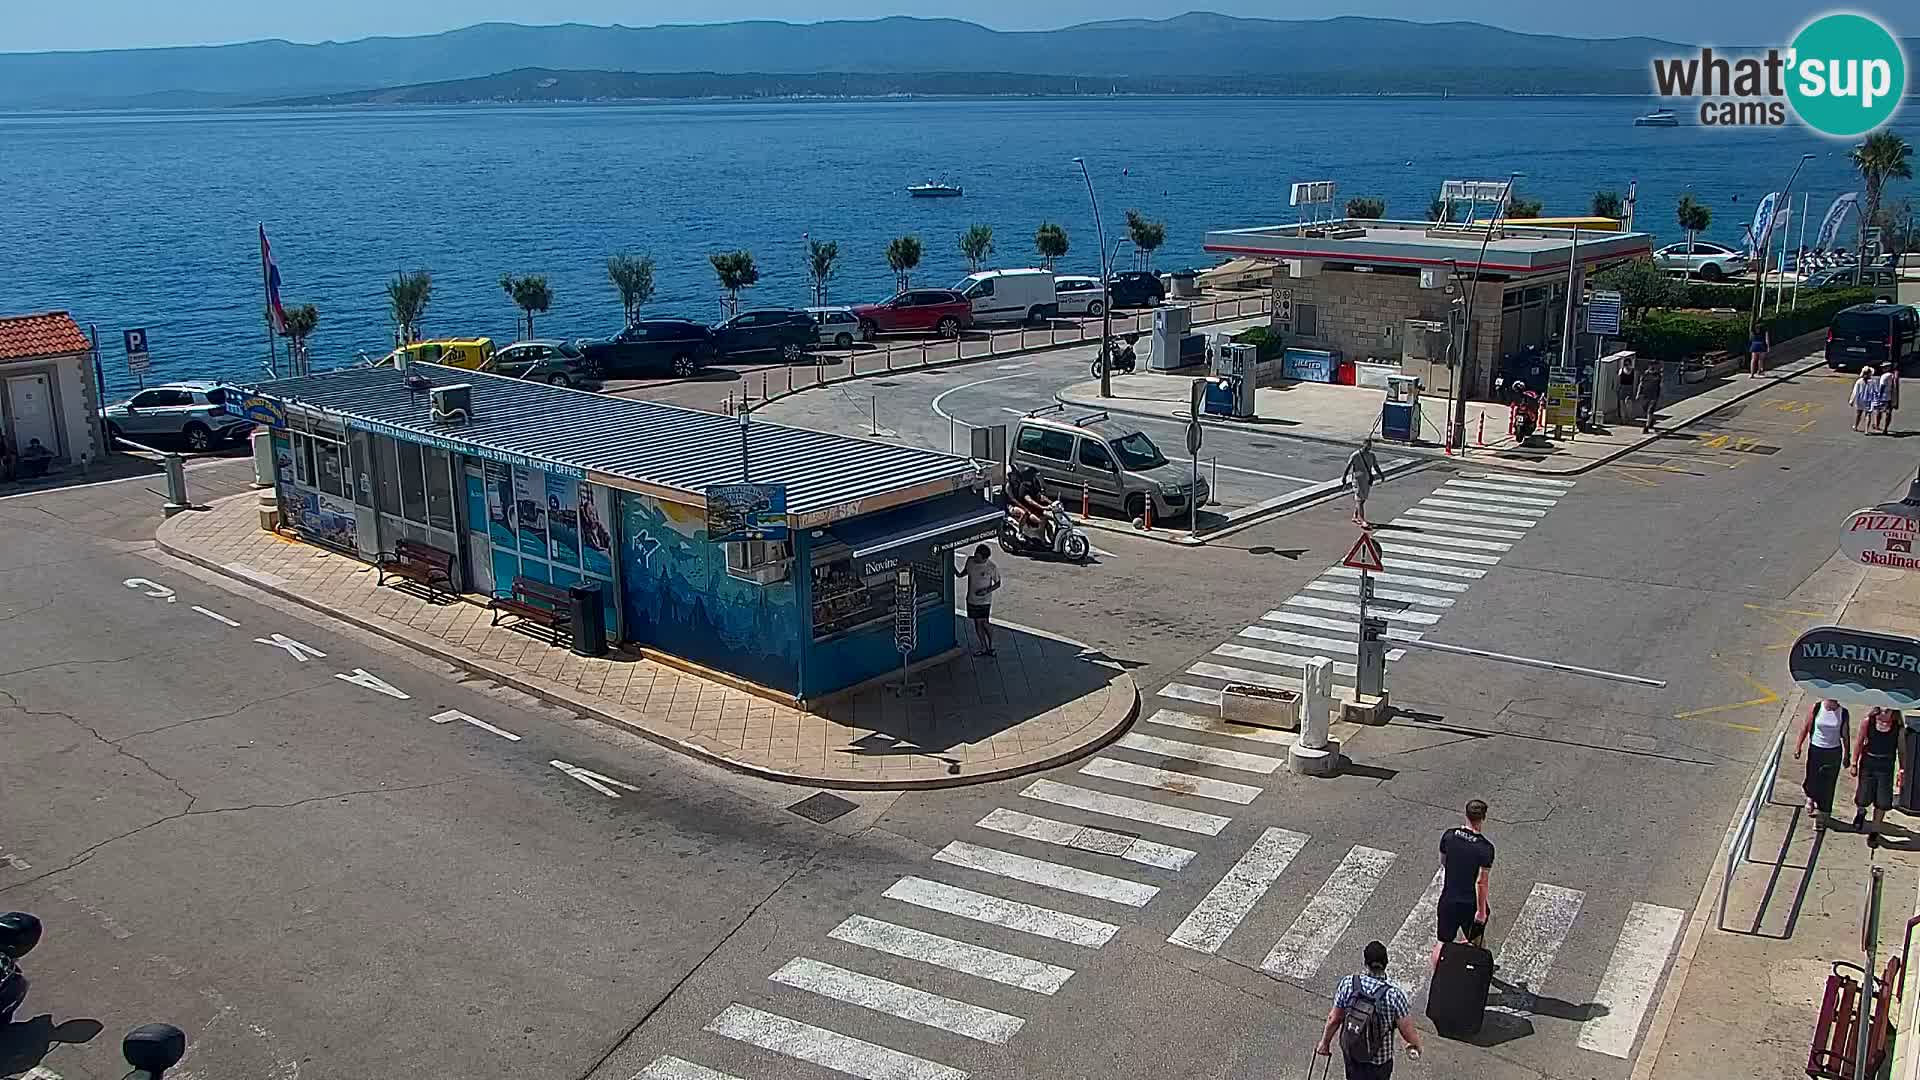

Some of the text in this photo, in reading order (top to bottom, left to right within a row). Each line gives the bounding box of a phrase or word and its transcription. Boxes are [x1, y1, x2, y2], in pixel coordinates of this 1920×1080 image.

[129, 332, 141, 350] P
[395, 429, 435, 446] AUTOBUSNA
[436, 438, 468, 453] POSTAJA
[478, 447, 493, 459] BUS
[494, 451, 526, 466] STATION
[528, 459, 554, 472] TICKET
[555, 465, 583, 478] OFFICE
[1850, 516, 1920, 533] PIZZE
[1802, 643, 1920, 674] MARINER
[1830, 662, 1899, 681] caffe bar
